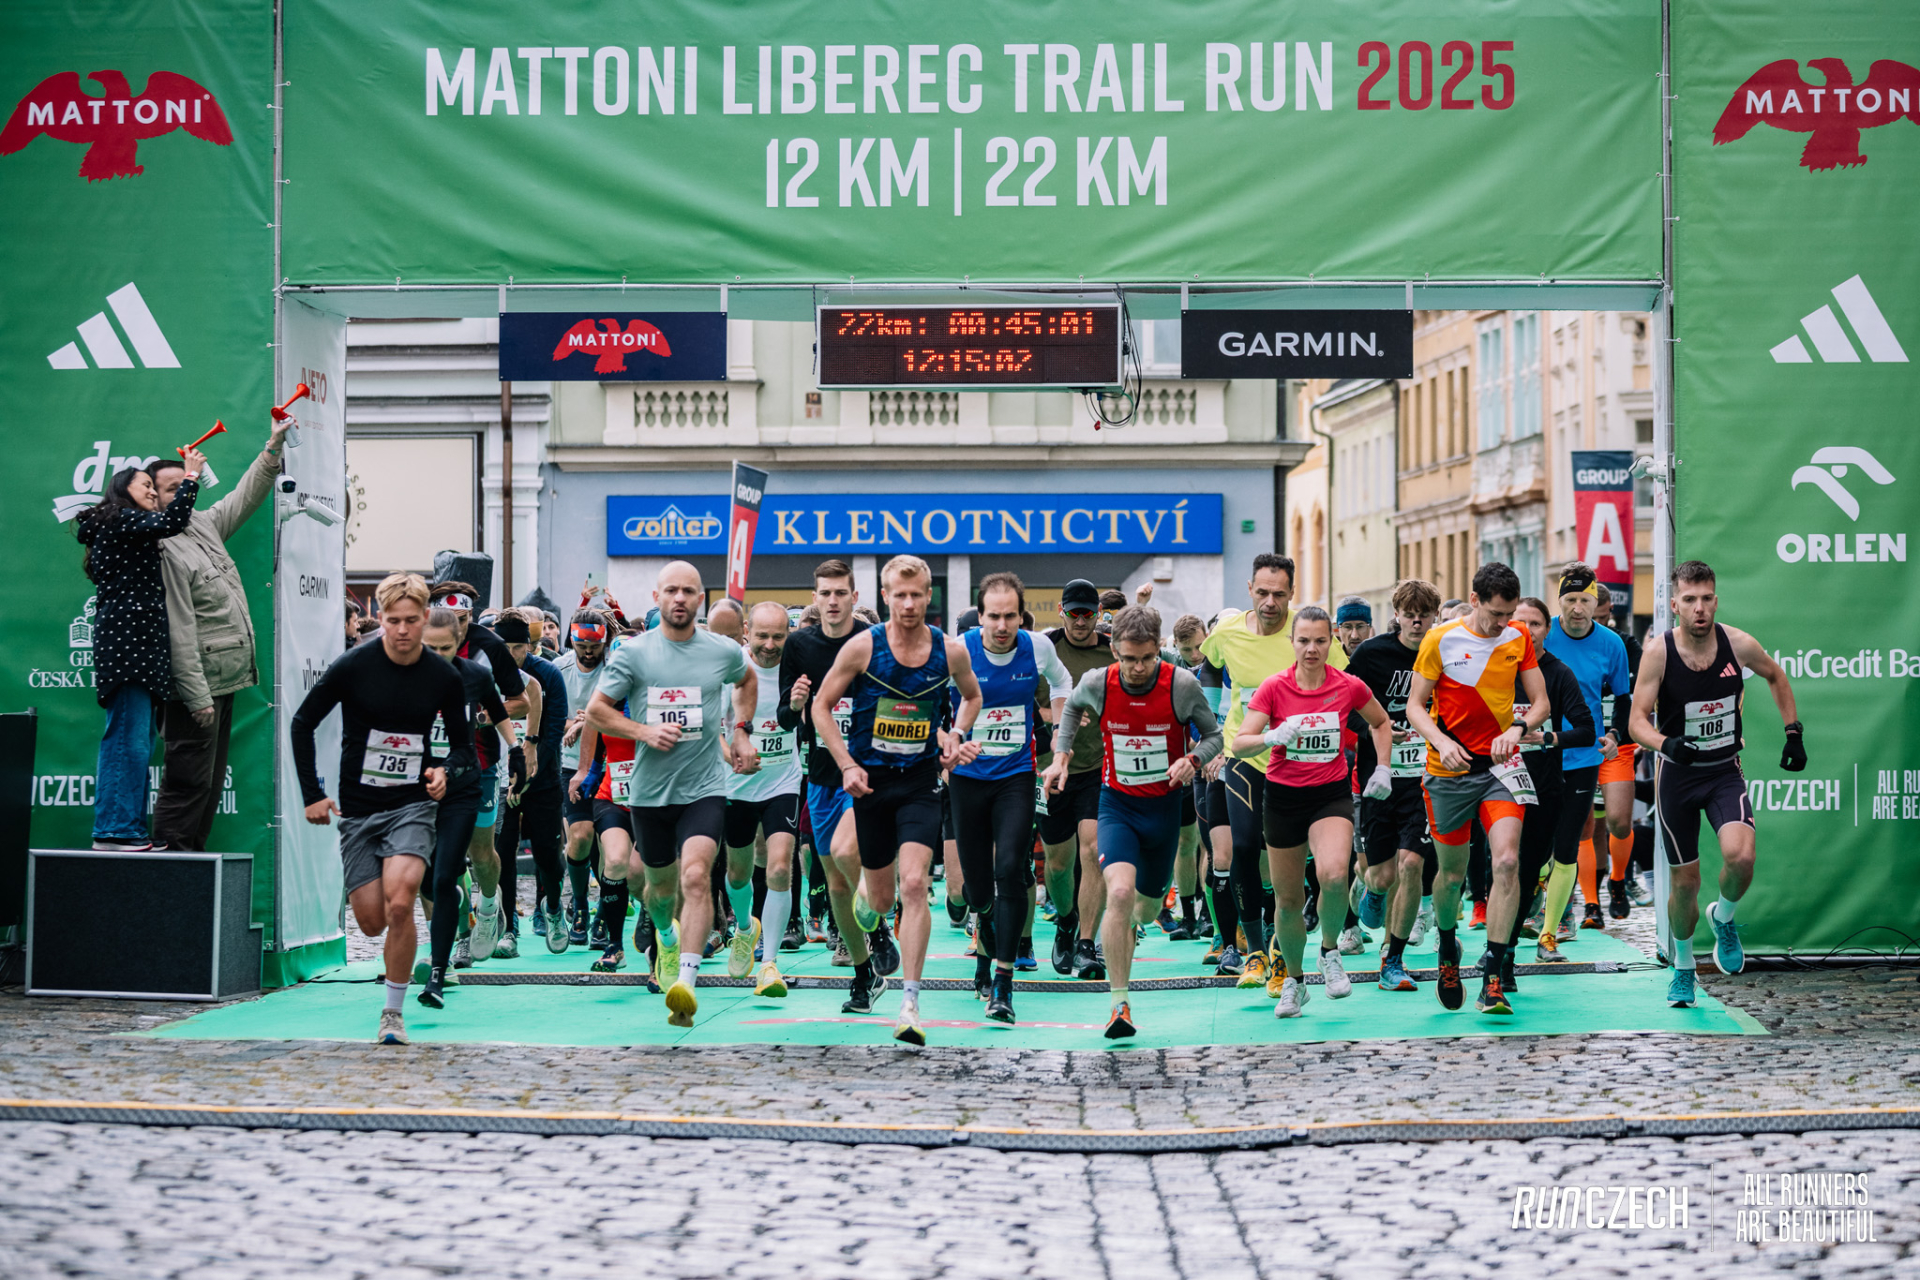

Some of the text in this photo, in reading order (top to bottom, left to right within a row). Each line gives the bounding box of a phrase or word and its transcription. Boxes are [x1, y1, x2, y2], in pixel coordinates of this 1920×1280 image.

[426, 40, 1516, 116] MATTONI LIBEREC TRAIL RUN 2025
[1745, 87, 1920, 114] MATTON
[27, 99, 202, 126] MATTONI
[766, 136, 1168, 208] 12 KM 22 KM
[568, 332, 656, 347] MATTONI
[1577, 469, 1630, 486] GROUP
[736, 483, 762, 506] GROUP
[773, 499, 1189, 545] KLENOTNICTVÍ
[1585, 503, 1630, 572] A
[1776, 533, 1907, 564] ORLEN
[730, 519, 749, 590] A
[299, 574, 330, 600] GARMIN
[1024, 599, 1056, 612] LATÉ
[28, 667, 86, 688] ČESKÁ
[659, 711, 687, 727] 105
[877, 721, 926, 739] ONDŘEJ
[1698, 719, 1724, 736] 108
[761, 737, 783, 752] 128
[987, 728, 1011, 742] 770
[1297, 735, 1330, 749] F105
[379, 754, 408, 772] 735
[1132, 757, 1148, 771] 11
[1399, 748, 1420, 763] 112
[31, 775, 97, 806] CZEC
[1877, 770, 1900, 794] ALL
[1872, 795, 1920, 820] ARE BE
